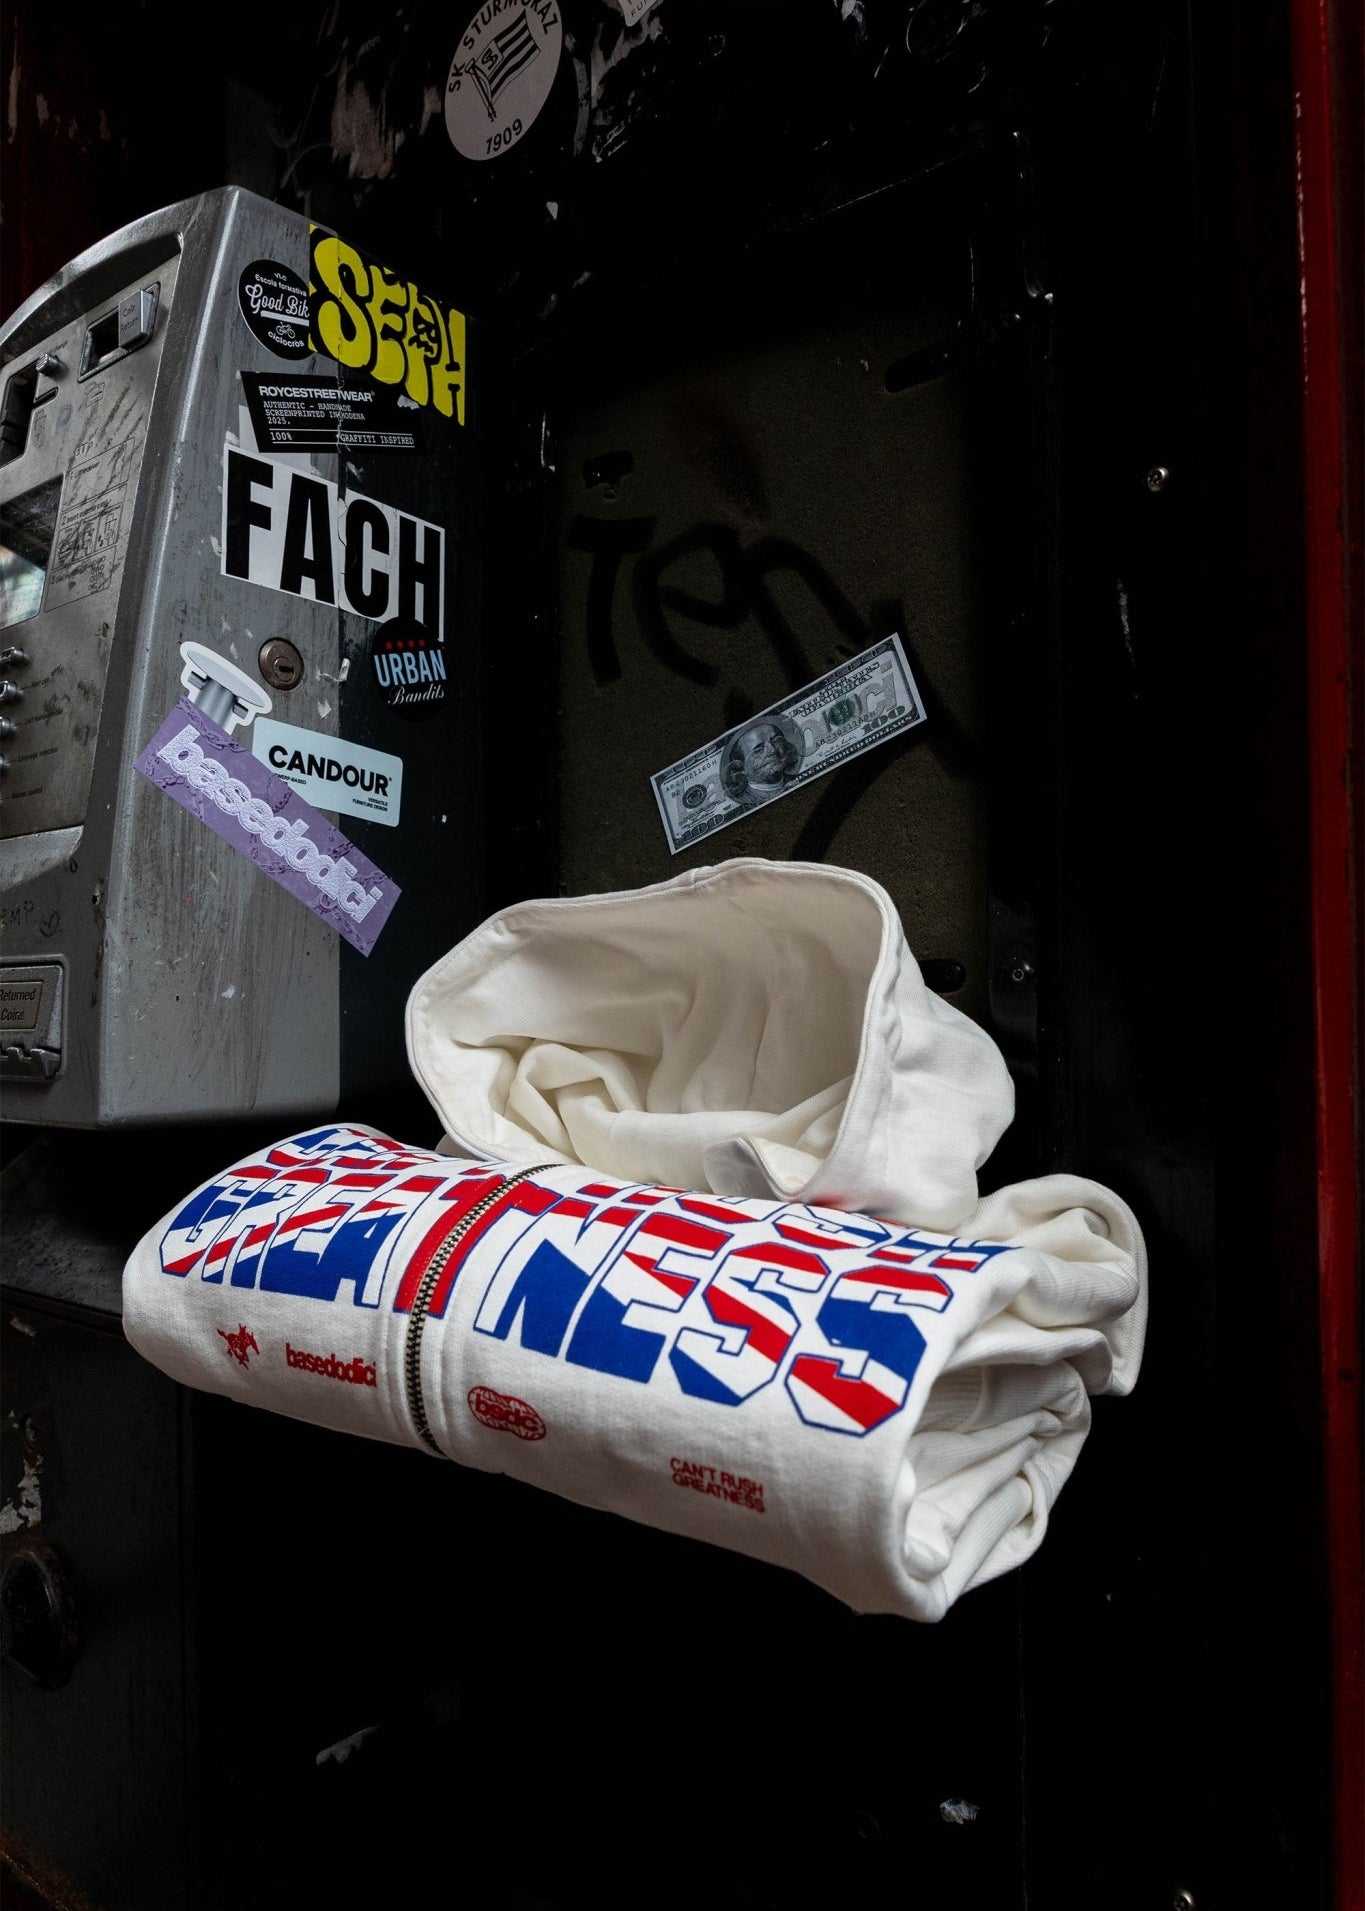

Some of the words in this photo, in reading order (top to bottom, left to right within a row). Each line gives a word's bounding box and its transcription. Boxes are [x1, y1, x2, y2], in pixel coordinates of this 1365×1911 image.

[449, 62, 465, 92] SK
[486, 118, 522, 154] 1909
[255, 274, 277, 287] Escola
[245, 284, 284, 314] Good
[263, 401, 306, 410] AUTHENTIC
[318, 403, 352, 412] HANDMADE
[265, 409, 326, 418] SCREENPRINTED
[270, 431, 293, 441] 100%
[340, 433, 376, 443] GRAFFITI
[380, 436, 415, 445] INSPIRED
[225, 449, 441, 639] FACH
[373, 648, 447, 687] URBAN
[387, 683, 445, 705] Bandits
[861, 703, 906, 736] 100
[269, 745, 388, 797] CANDOUR
[157, 724, 383, 923] basedodici
[159, 1165, 953, 1438] GREATNESS
[672, 1471, 765, 1513] GREATNESS
[721, 1471, 763, 1497] RUSH
